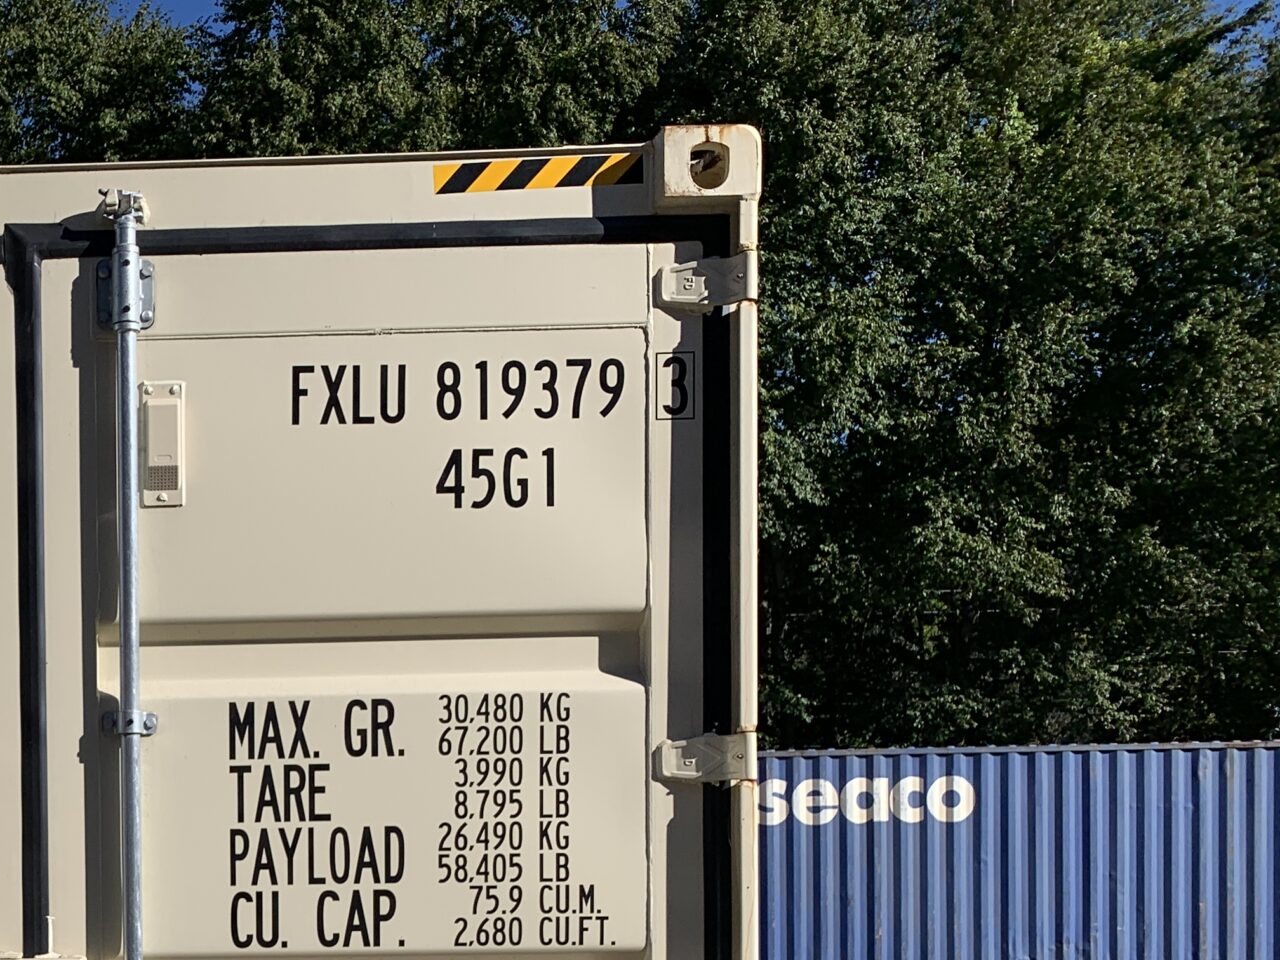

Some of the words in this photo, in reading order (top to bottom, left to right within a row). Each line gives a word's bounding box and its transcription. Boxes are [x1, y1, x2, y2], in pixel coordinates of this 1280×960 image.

[291, 364, 407, 425] FXLU
[436, 358, 625, 421] 819379
[662, 356, 688, 416] 3
[436, 447, 555, 509] 45G1
[438, 693, 524, 725] 30,480
[539, 692, 571, 723] KG
[228, 700, 321, 760] MAX.
[343, 698, 406, 757] GR.
[438, 725, 524, 757] 67,200
[539, 724, 571, 755] LB
[454, 757, 524, 788] 3,990
[539, 756, 570, 787] KG
[229, 763, 331, 823] TARE
[454, 789, 523, 820] 8,795
[539, 788, 570, 819] LB
[758, 776, 976, 826] seaco
[438, 821, 523, 853] 26,490
[539, 821, 570, 851] KG
[229, 826, 405, 886] PAYLOAD
[438, 853, 523, 885] 58,405
[539, 852, 570, 883] LB
[469, 885, 523, 915] 75.9
[539, 884, 602, 914] CU.M.
[230, 890, 288, 949] CU.
[316, 888, 406, 948] CAP.
[454, 917, 523, 948] 2,680
[538, 916, 616, 946] CU.FT.
